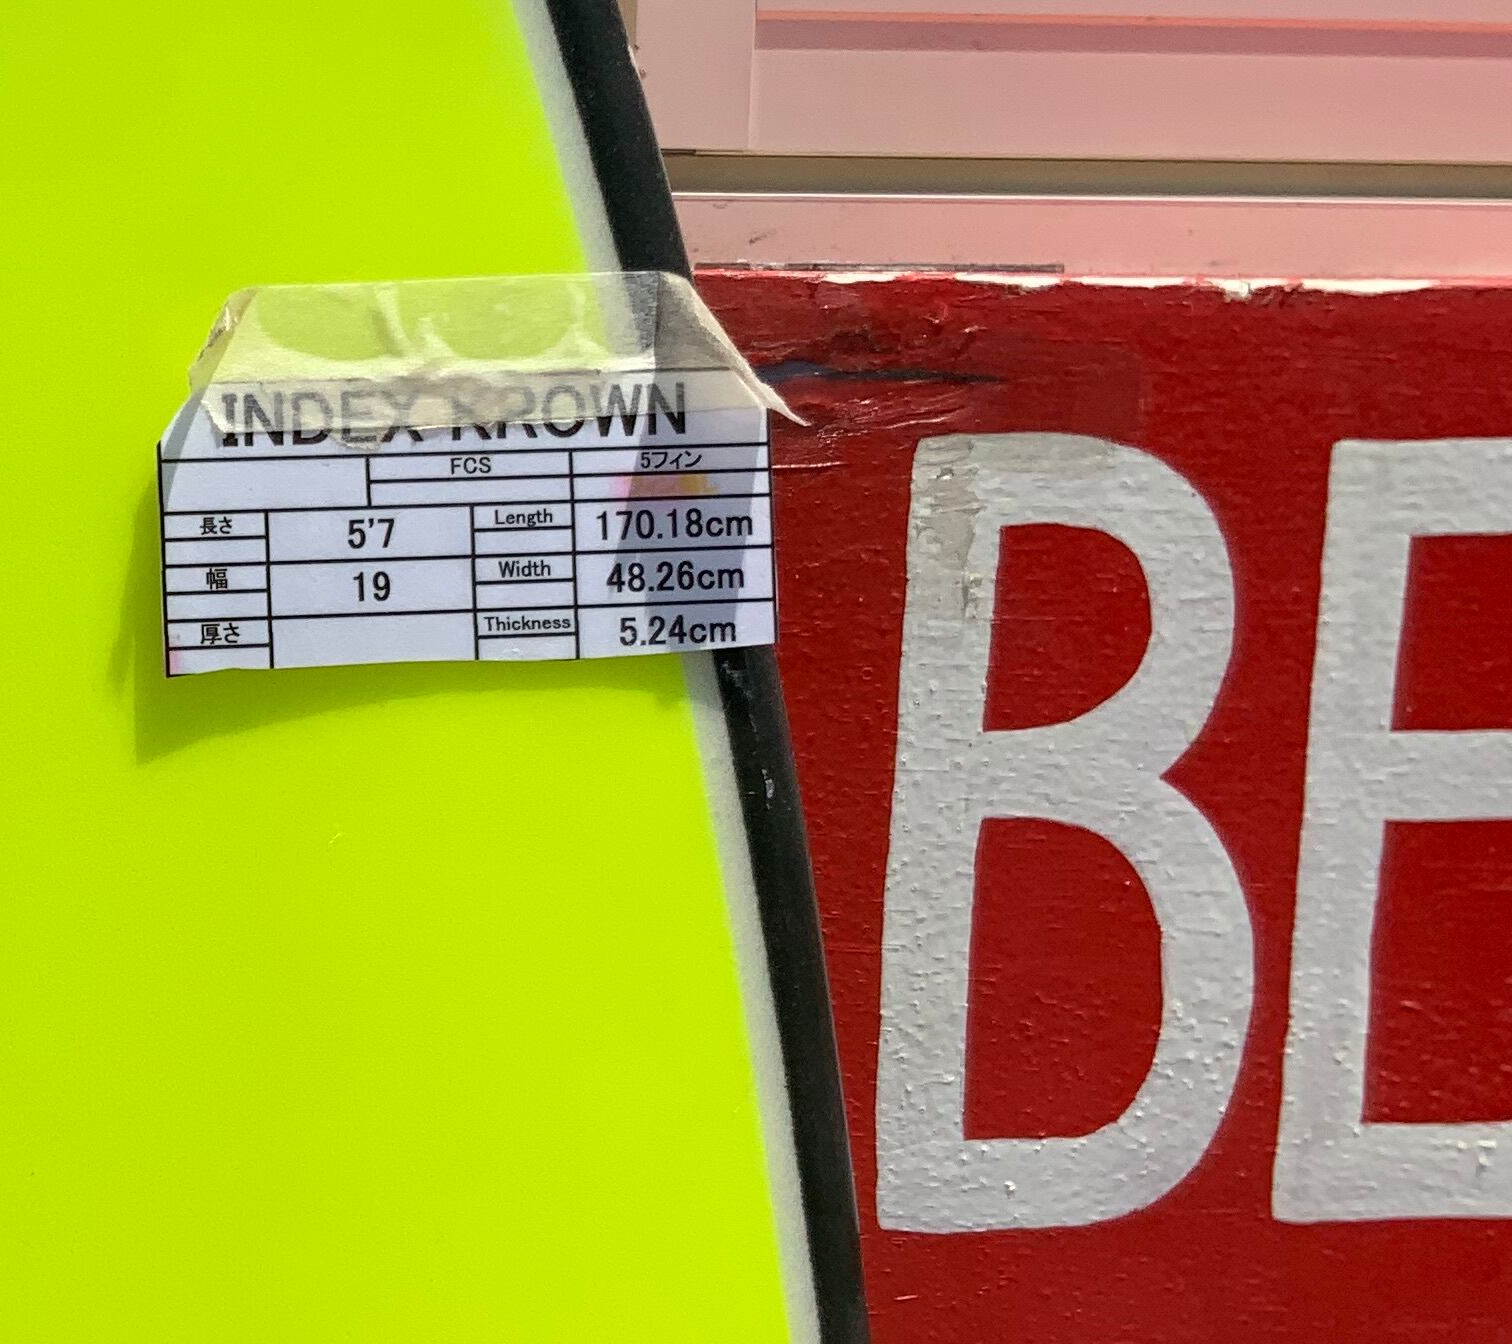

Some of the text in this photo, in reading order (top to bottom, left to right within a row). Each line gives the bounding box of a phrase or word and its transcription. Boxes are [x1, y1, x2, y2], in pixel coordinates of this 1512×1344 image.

[221, 382, 686, 447] INDEX KROWN
[450, 457, 492, 475] FCS
[640, 451, 703, 469] 5フィン
[199, 516, 233, 535] 長さ
[494, 509, 553, 528] Length
[596, 508, 753, 541] 170.18cm
[205, 567, 228, 590] 幅
[498, 560, 551, 578] Width
[606, 560, 745, 593] 48.26cm
[353, 571, 391, 602] 19
[200, 622, 240, 645] 厚さ
[483, 615, 571, 632] Thickness
[619, 614, 737, 646] 5.24cm
